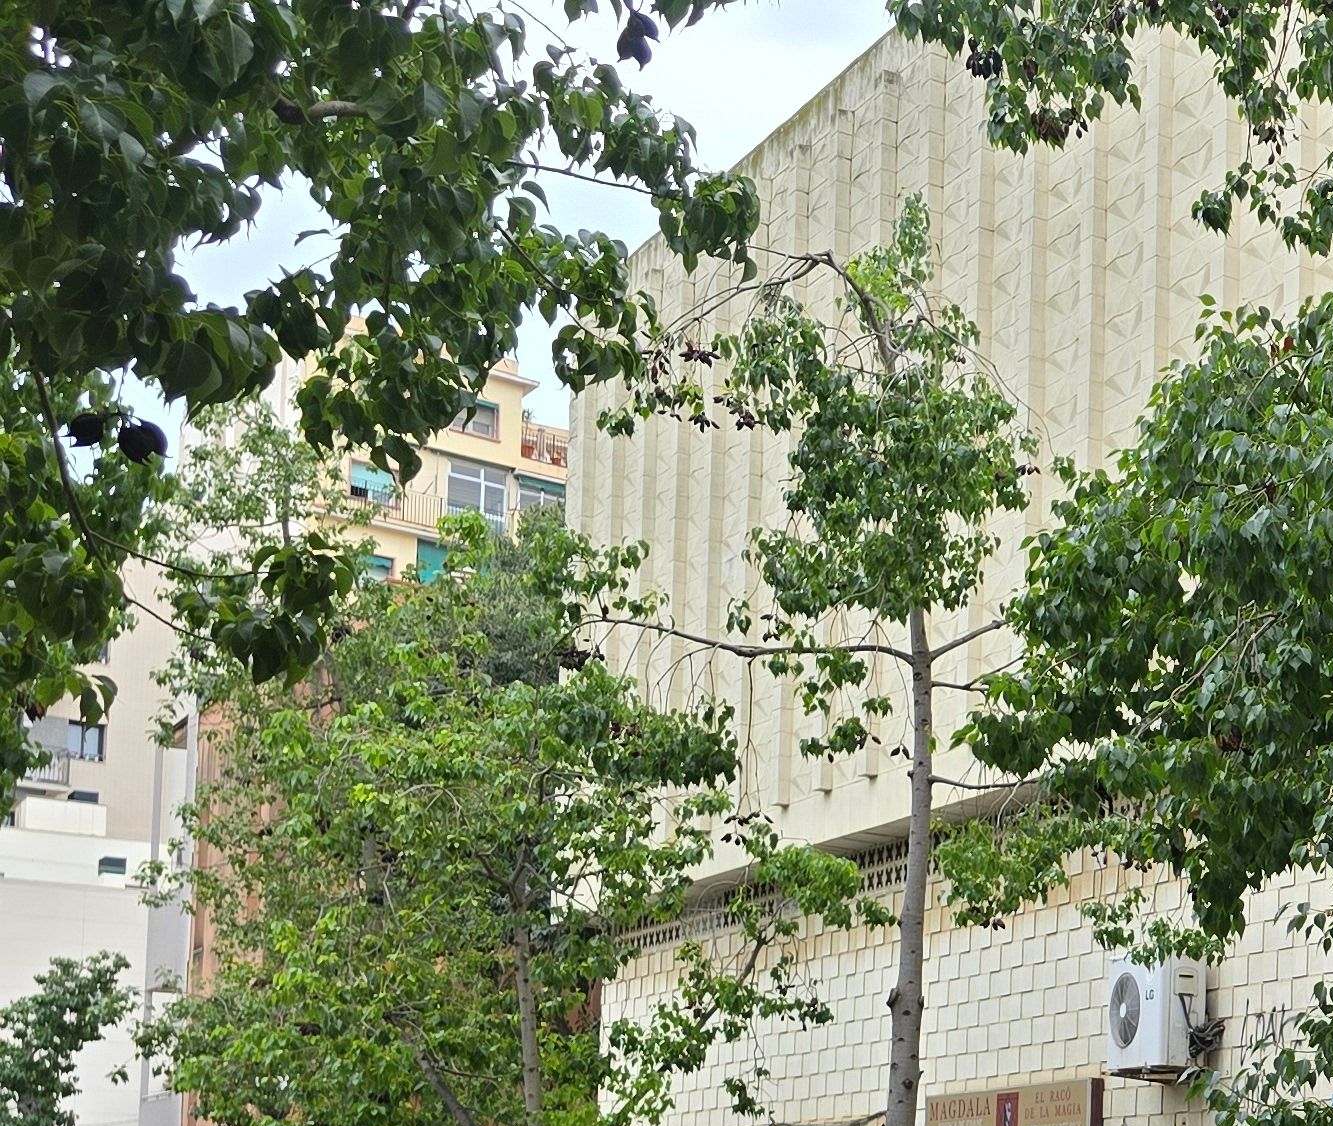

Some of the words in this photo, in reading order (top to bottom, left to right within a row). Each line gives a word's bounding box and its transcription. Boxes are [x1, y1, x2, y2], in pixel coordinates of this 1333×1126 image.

[1145, 988, 1155, 1001] LG
[1034, 1091, 1045, 1104] EL
[1050, 1086, 1071, 1102] RACÓ
[929, 1097, 991, 1121] MAGDALA
[1024, 1107, 1036, 1120] DE
[1039, 1105, 1050, 1118] LA
[1054, 1102, 1082, 1117] MAGIA
